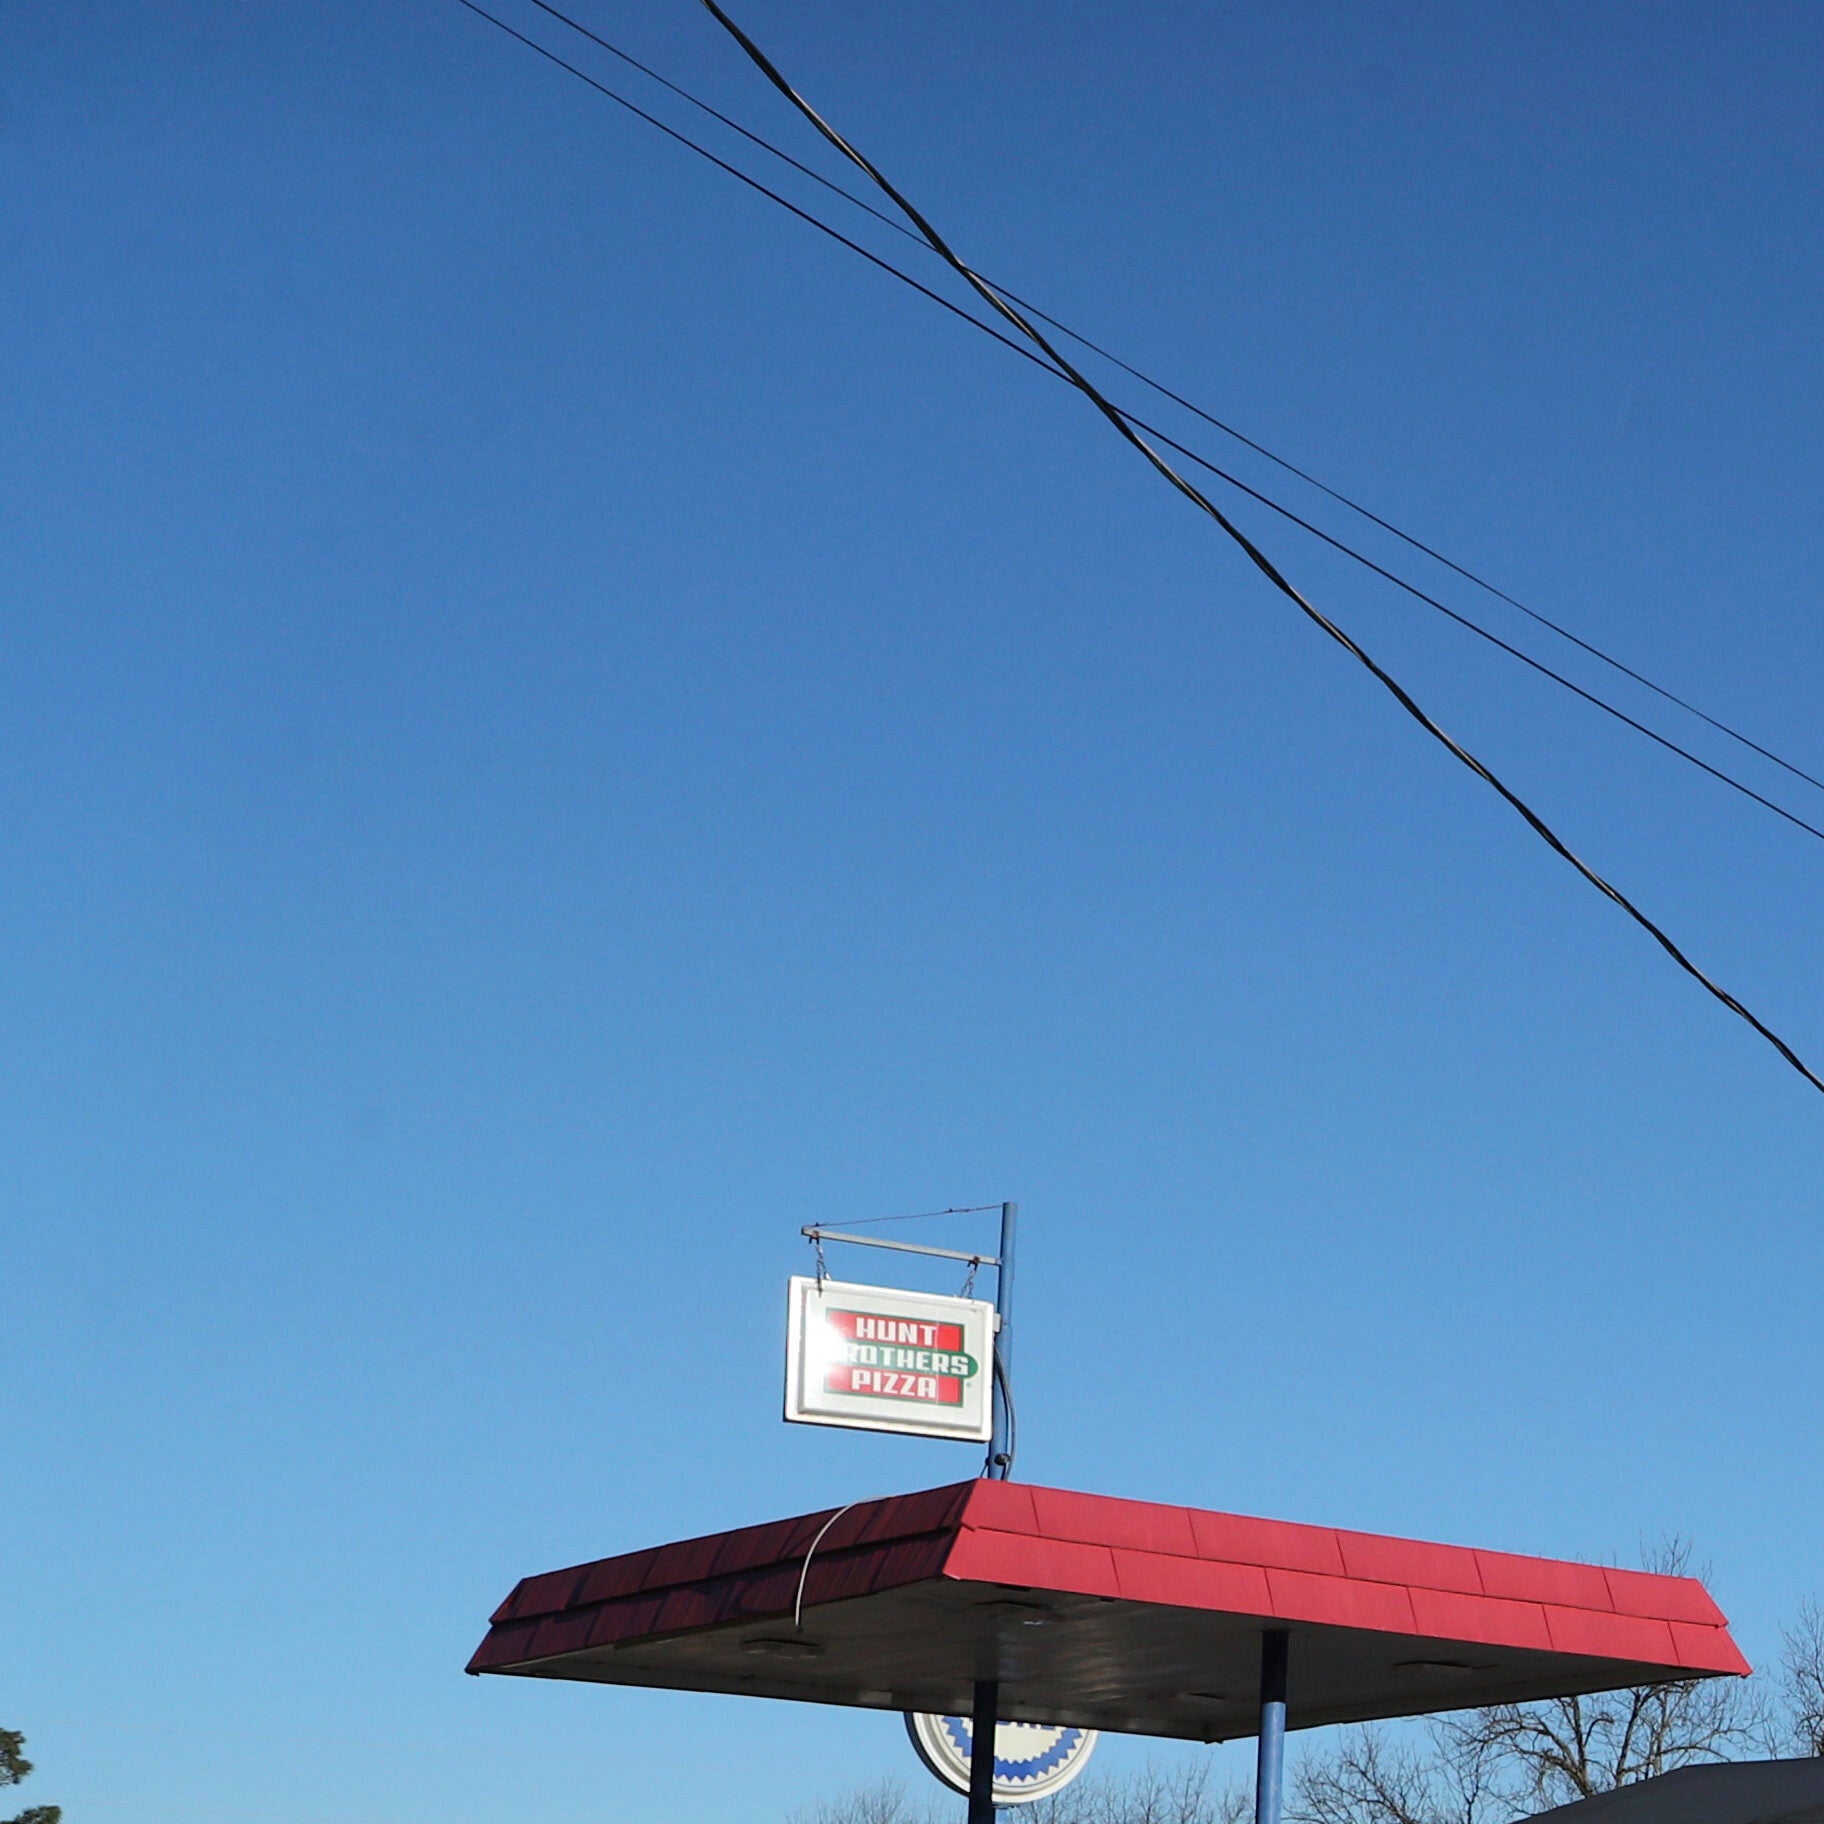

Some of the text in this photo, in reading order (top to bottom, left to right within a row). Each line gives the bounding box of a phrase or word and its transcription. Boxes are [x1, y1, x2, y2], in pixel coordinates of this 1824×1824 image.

[855, 1316, 939, 1347] HUNT
[845, 1343, 970, 1377] ROTHERS
[851, 1368, 938, 1400] PIZZA
